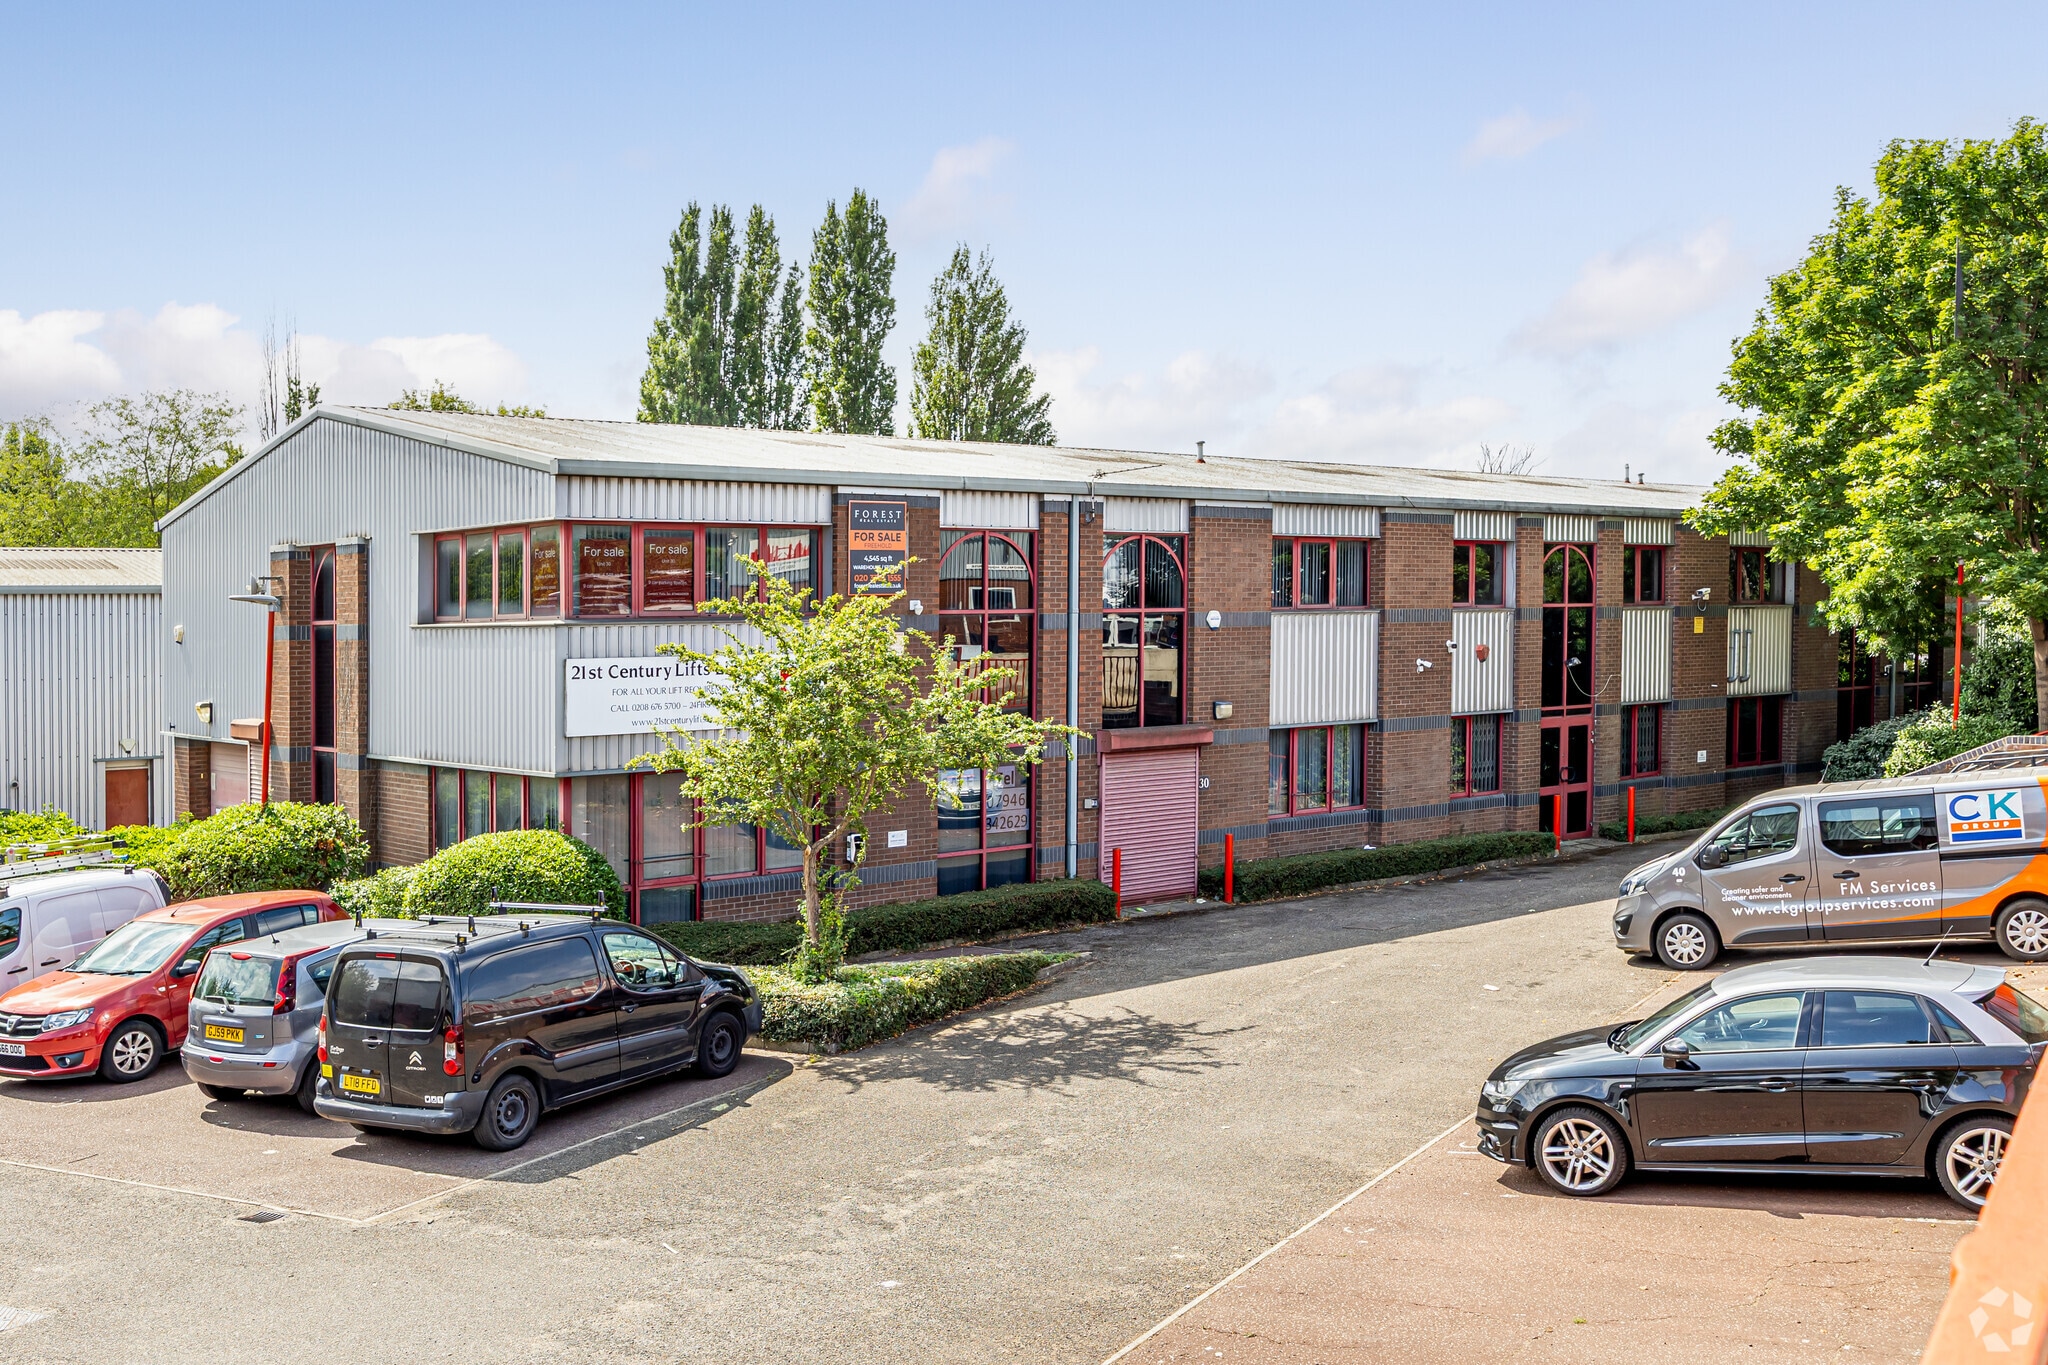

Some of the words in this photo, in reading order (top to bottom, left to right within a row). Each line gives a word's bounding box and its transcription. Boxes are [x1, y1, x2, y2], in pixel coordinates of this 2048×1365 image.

[854, 510, 902, 519] FOREST
[854, 532, 875, 541] FOR
[878, 532, 902, 542] SALE
[534, 548, 545, 559] For
[545, 547, 556, 559] sale
[584, 546, 602, 557] For
[603, 546, 625, 557] sale
[649, 544, 665, 555] For
[668, 544, 689, 555] sale
[854, 574, 869, 582] 020
[887, 574, 902, 582] 1555
[571, 665, 603, 680] 21st
[608, 664, 672, 681] Century
[675, 662, 711, 678] Lifts
[612, 688, 628, 697] FOR
[630, 688, 645, 696] ALL
[645, 687, 667, 696] YOUR
[668, 686, 683, 695] LIFT
[610, 704, 630, 713] CALL
[631, 703, 649, 712] 0208
[650, 702, 663, 712] 676
[664, 702, 681, 711] 5700
[631, 714, 708, 727] www.21stcenturylift
[997, 770, 1014, 785] el
[1198, 777, 1210, 789] 30
[986, 792, 1026, 809] 07946
[1949, 792, 2020, 821] CK
[1962, 821, 2010, 830] GROUP
[1672, 867, 1686, 877] 40
[1721, 887, 1750, 896] Creating
[1751, 886, 1769, 894] safer
[1770, 885, 1784, 893] and
[1840, 882, 1864, 896] FM
[1870, 879, 1937, 894] Services
[1748, 892, 1793, 901] environments
[1732, 897, 1935, 917] www.ckgroupservices.com
[208, 1026, 225, 1038] GJ59
[226, 1028, 240, 1040] PKK
[344, 1076, 359, 1088] LT18
[361, 1079, 377, 1091] FFD
